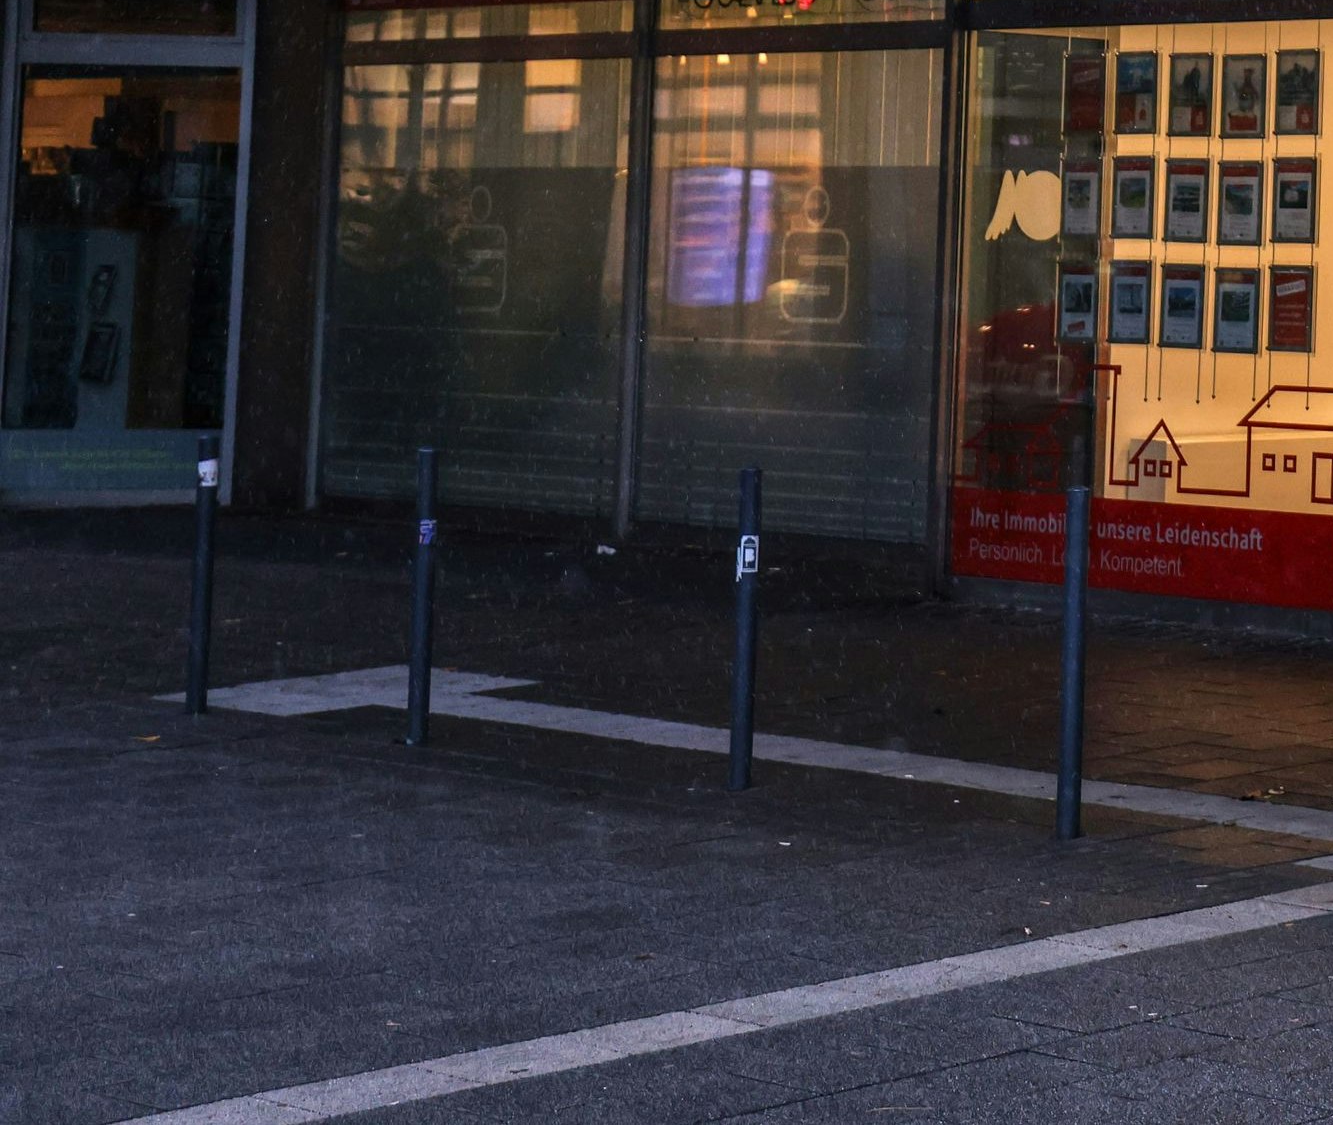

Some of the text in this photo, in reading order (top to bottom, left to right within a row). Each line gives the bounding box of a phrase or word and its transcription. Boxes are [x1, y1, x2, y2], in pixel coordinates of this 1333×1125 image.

[970, 508, 999, 529] Ihre
[1004, 510, 1067, 533] Immobil
[1097, 521, 1151, 543] unsere
[1155, 523, 1263, 551] Leidenschaft
[1100, 549, 1184, 577] Kompetent.
